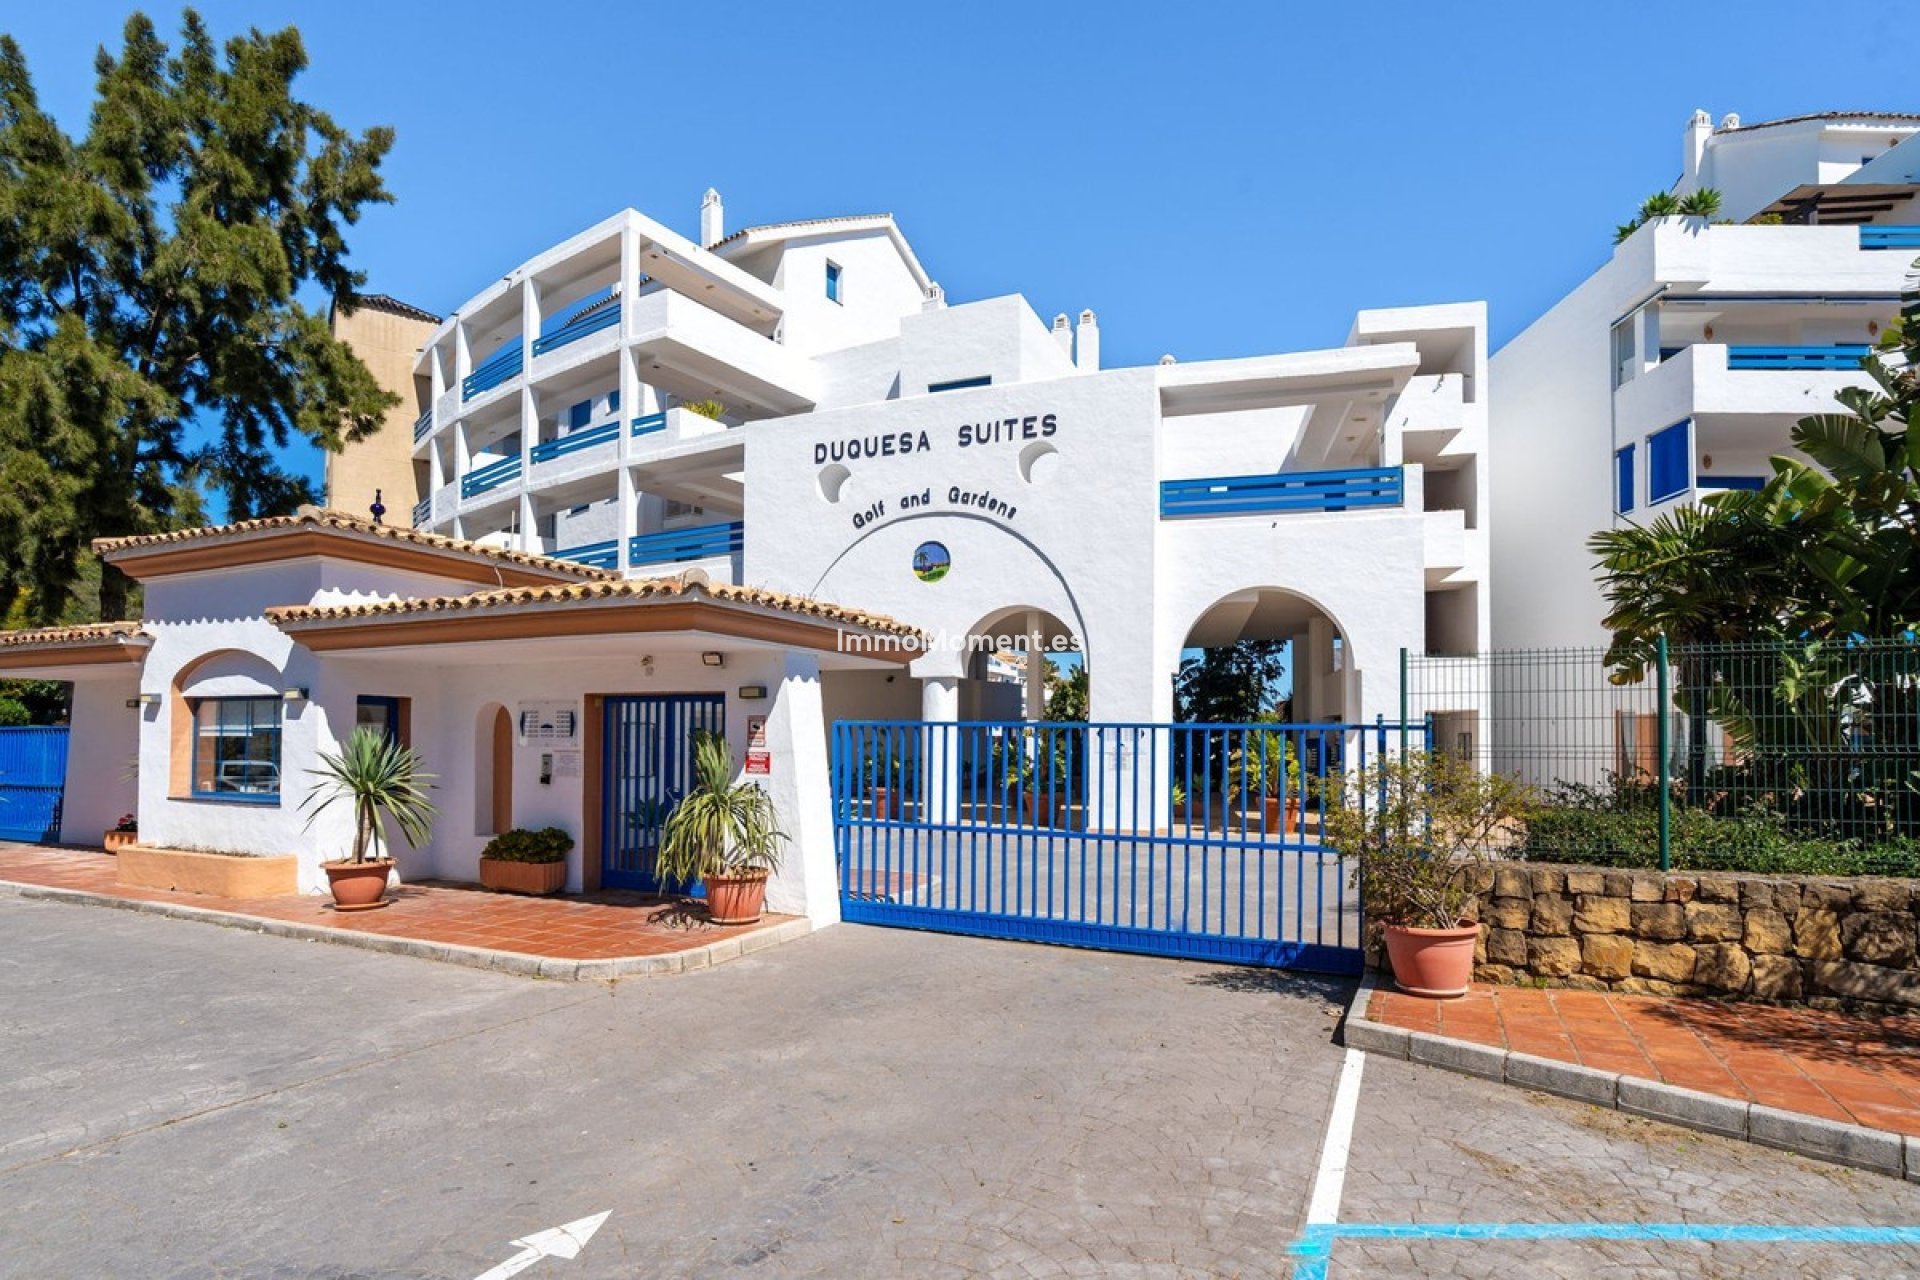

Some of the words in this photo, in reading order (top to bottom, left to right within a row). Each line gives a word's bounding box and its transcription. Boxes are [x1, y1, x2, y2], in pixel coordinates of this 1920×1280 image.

[814, 430, 931, 464] DUQUESA
[958, 414, 1057, 447] SUITES
[852, 500, 885, 529] Golf
[900, 487, 931, 509] and
[948, 486, 1017, 520] Gardens
